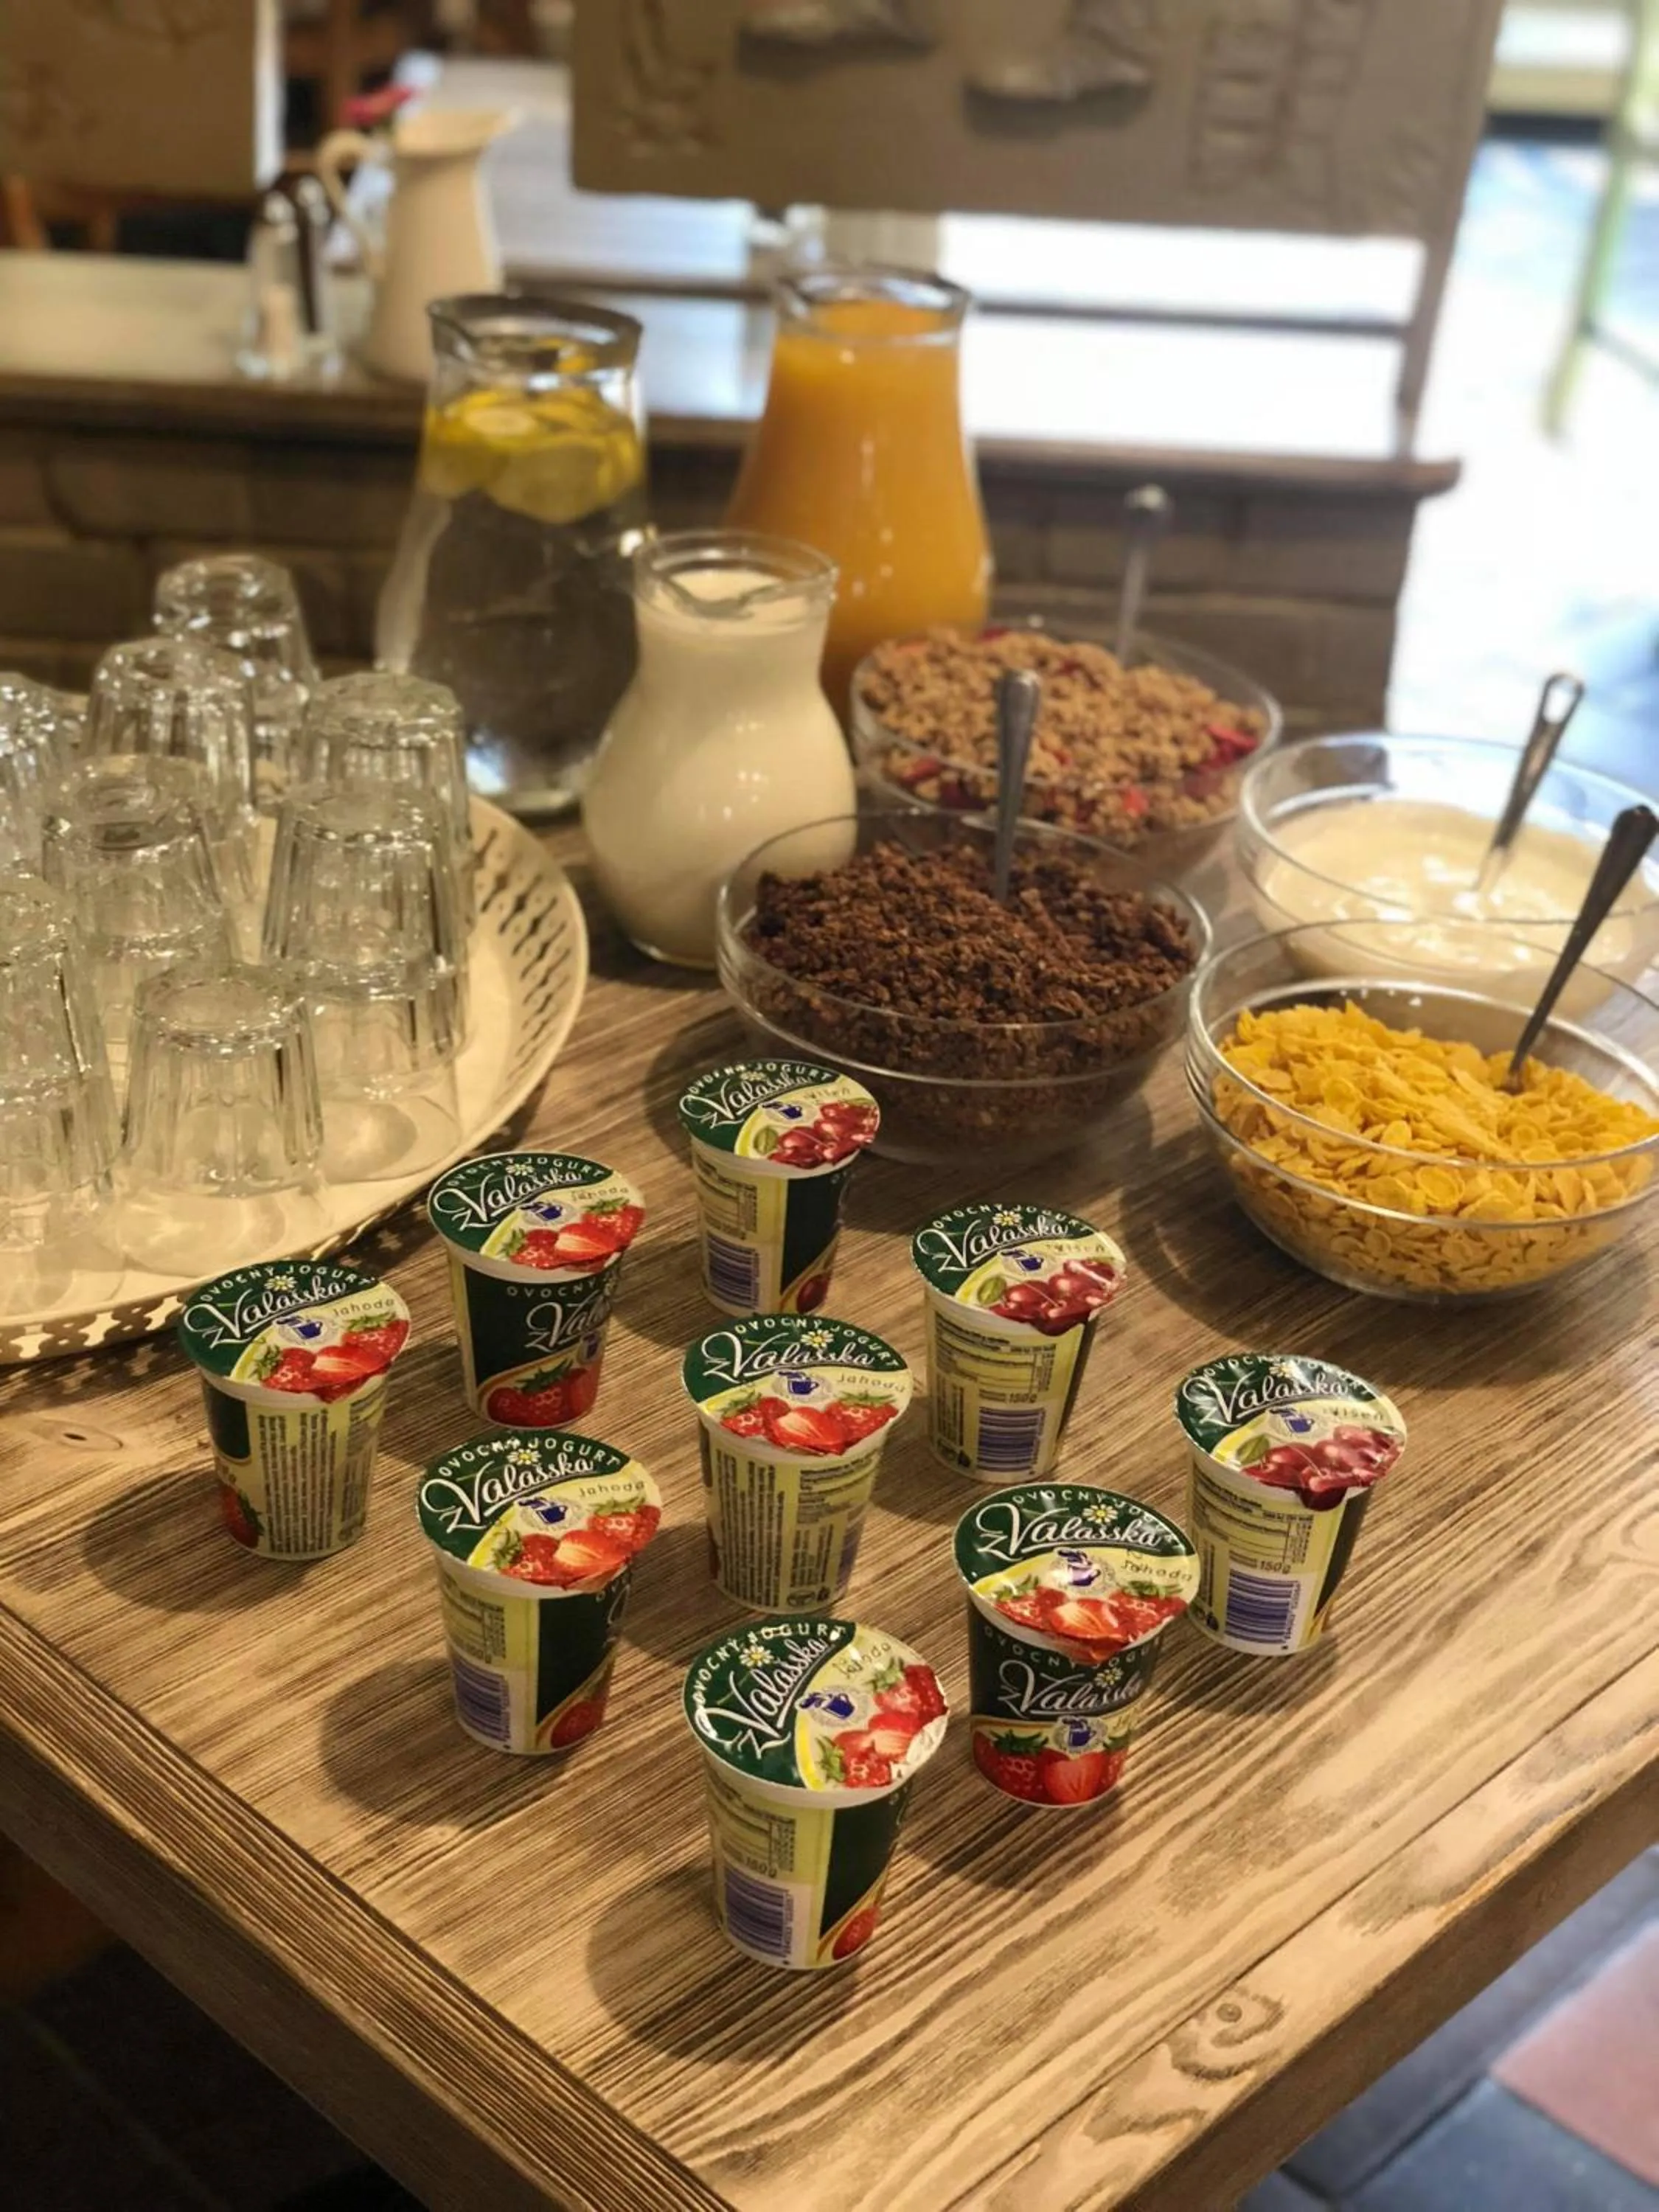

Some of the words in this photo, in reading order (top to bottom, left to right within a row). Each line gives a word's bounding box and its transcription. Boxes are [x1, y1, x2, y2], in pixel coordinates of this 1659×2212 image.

[524, 1157, 605, 1178] JOGURT
[286, 1265, 375, 1286] JOGURT
[830, 1325, 900, 1367] JOGURT
[528, 1437, 621, 1466] JOGURT
